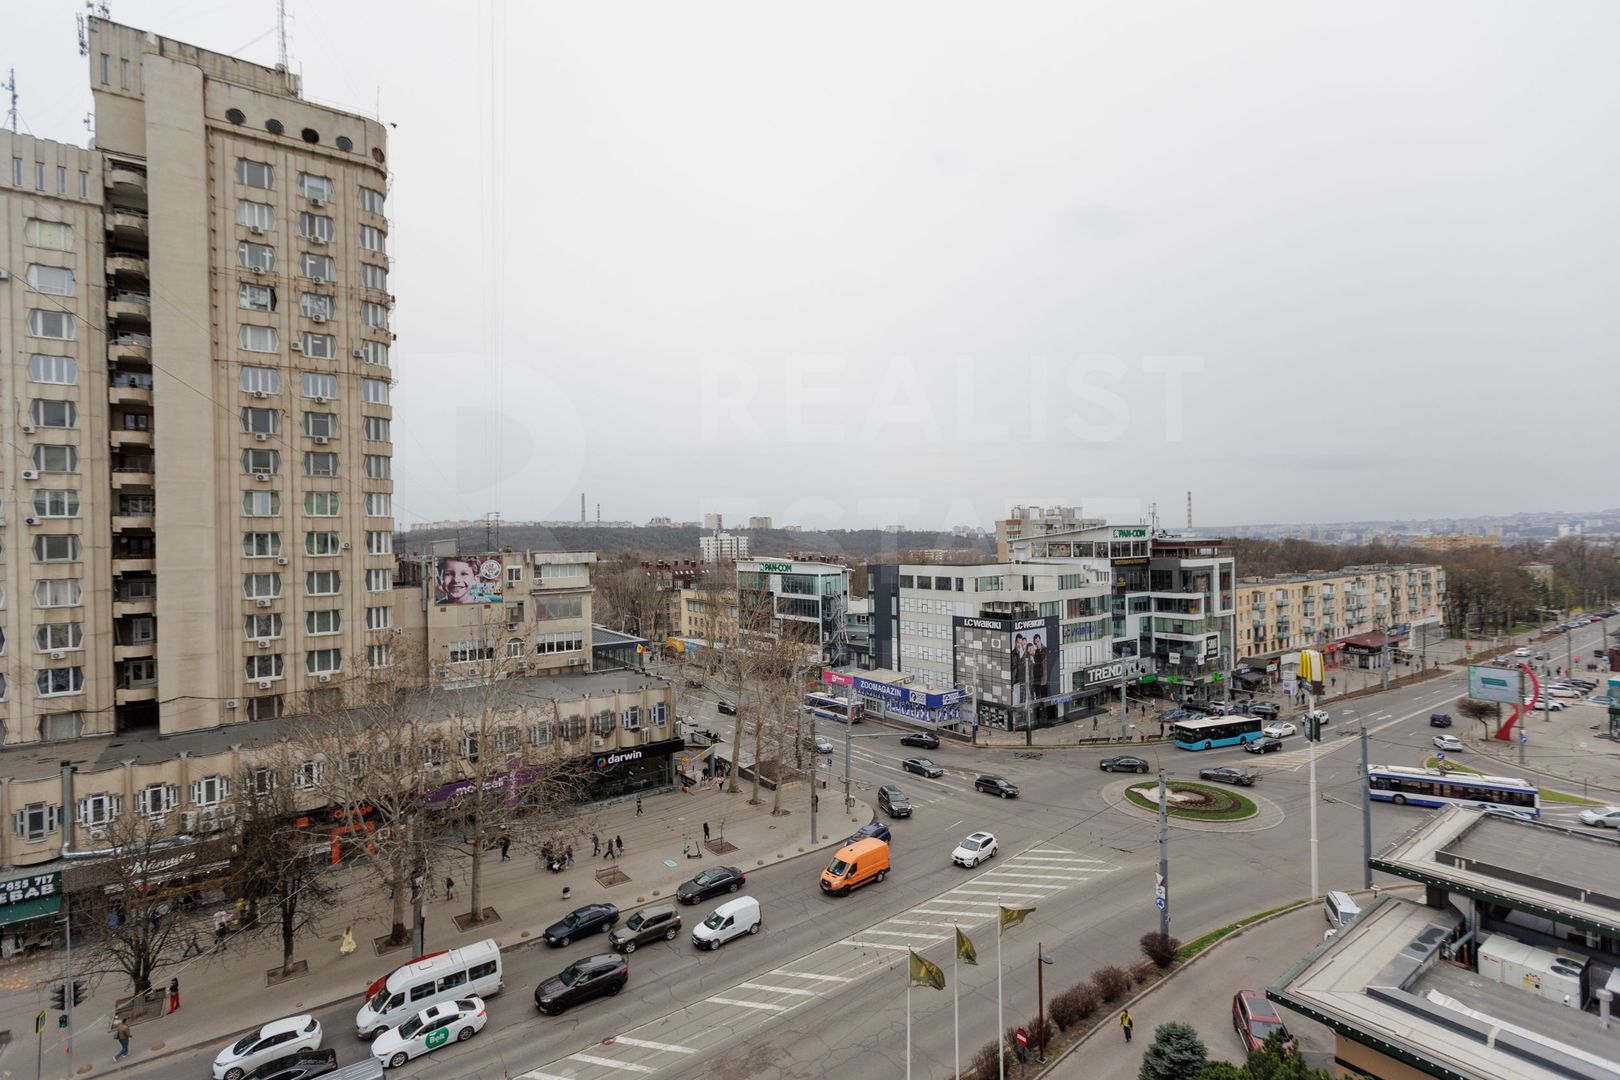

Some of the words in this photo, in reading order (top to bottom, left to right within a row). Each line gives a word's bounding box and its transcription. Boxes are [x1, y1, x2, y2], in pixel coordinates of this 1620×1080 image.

[765, 563, 792, 572] PAN-COM
[860, 680, 902, 697] ZOOMAGAZIN
[607, 750, 642, 765] darwin
[430, 1033, 445, 1044] Bolt
